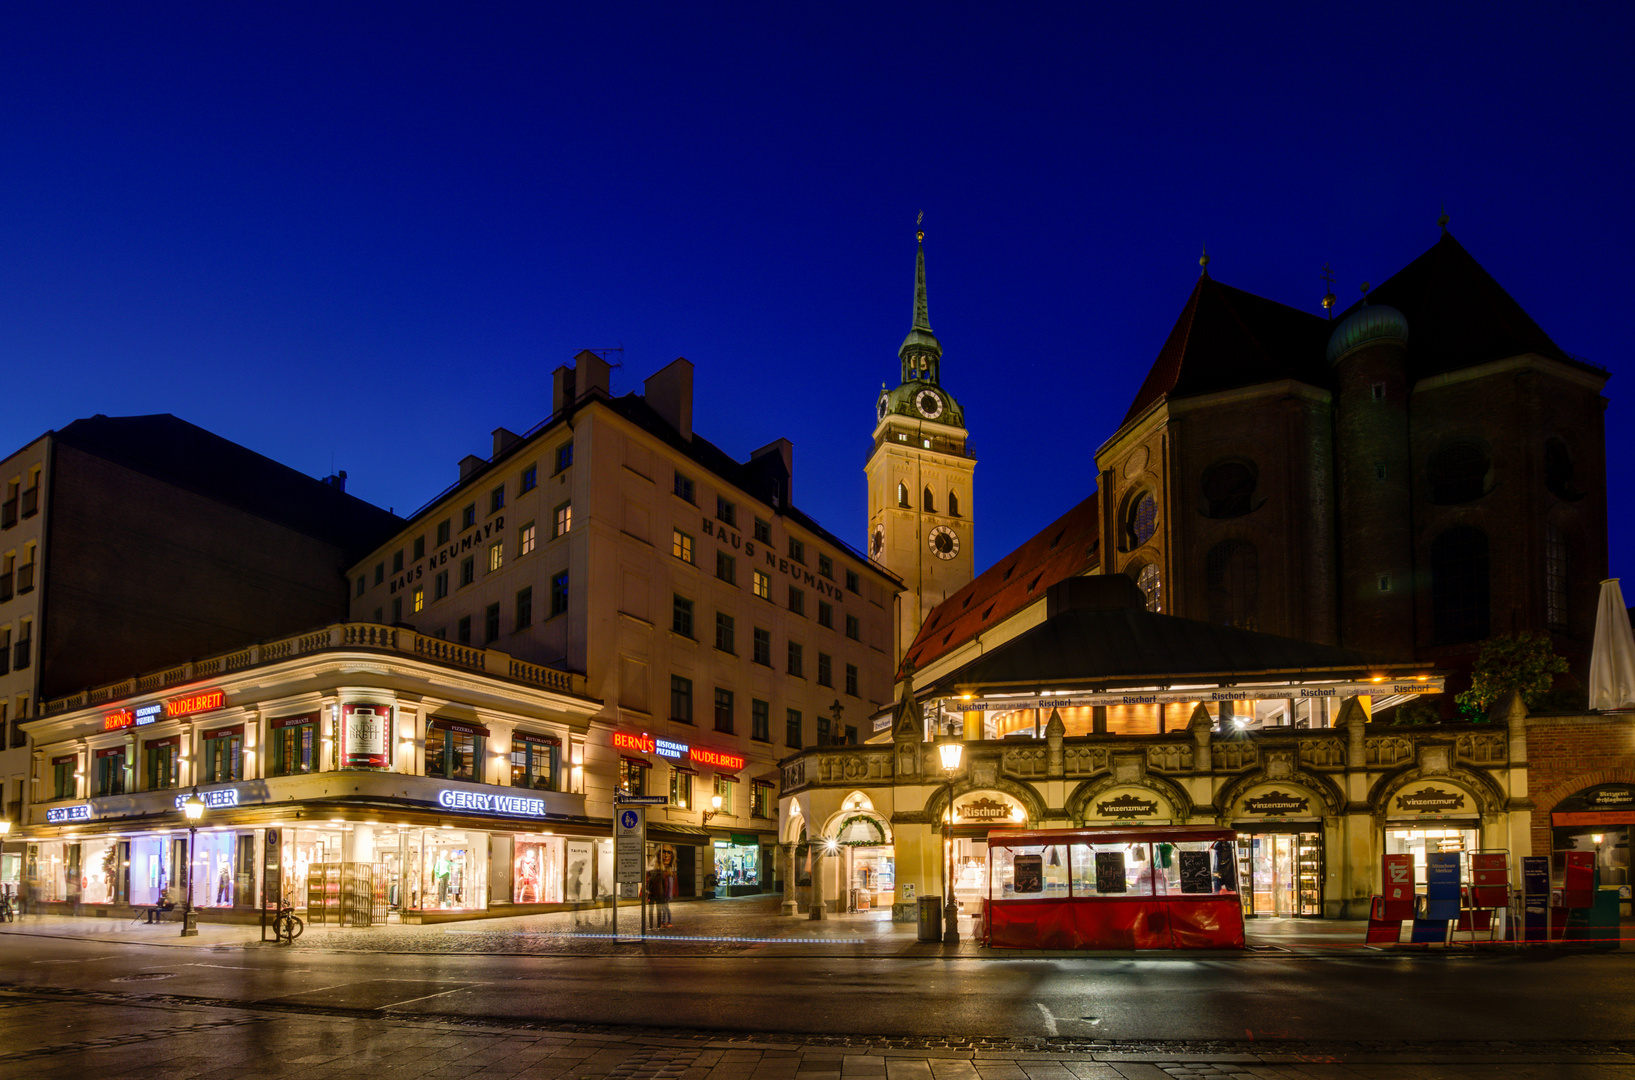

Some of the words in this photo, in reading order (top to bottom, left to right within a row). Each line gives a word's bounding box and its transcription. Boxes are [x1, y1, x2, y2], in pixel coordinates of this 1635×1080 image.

[390, 565, 423, 594] HAUS
[430, 516, 505, 570] NEUMAYR
[702, 517, 755, 557] HAUS
[766, 551, 843, 603] NEUMAYR
[1300, 687, 1337, 697] Rischart
[1394, 684, 1430, 693] Rischart
[1122, 695, 1157, 704] Rischart
[1211, 691, 1246, 701] Rischart
[167, 692, 223, 716] NUDELBRETT
[956, 702, 989, 711] Rischart
[1038, 699, 1072, 707] Rischart
[136, 704, 162, 717] RISTORANTE
[104, 710, 132, 730] BERNI'S
[136, 715, 155, 726] PIZZERIA
[285, 717, 310, 726] RISTORANTE
[451, 725, 475, 734] PIZZERIA
[525, 736, 552, 745] RISTORANTE
[614, 733, 655, 752] BERNI'S
[656, 739, 689, 752] RISTORANTE
[656, 747, 681, 758] PIZZERIA
[690, 749, 744, 769] NUDELBRETT
[203, 788, 238, 808] WEBER
[1598, 790, 1630, 798] Metzgerei
[439, 790, 496, 811] GERRY
[494, 795, 546, 816] WEBER
[1104, 804, 1150, 812] vinzenzmurr
[964, 806, 1006, 817] Rischart
[1388, 862, 1409, 883] tz
